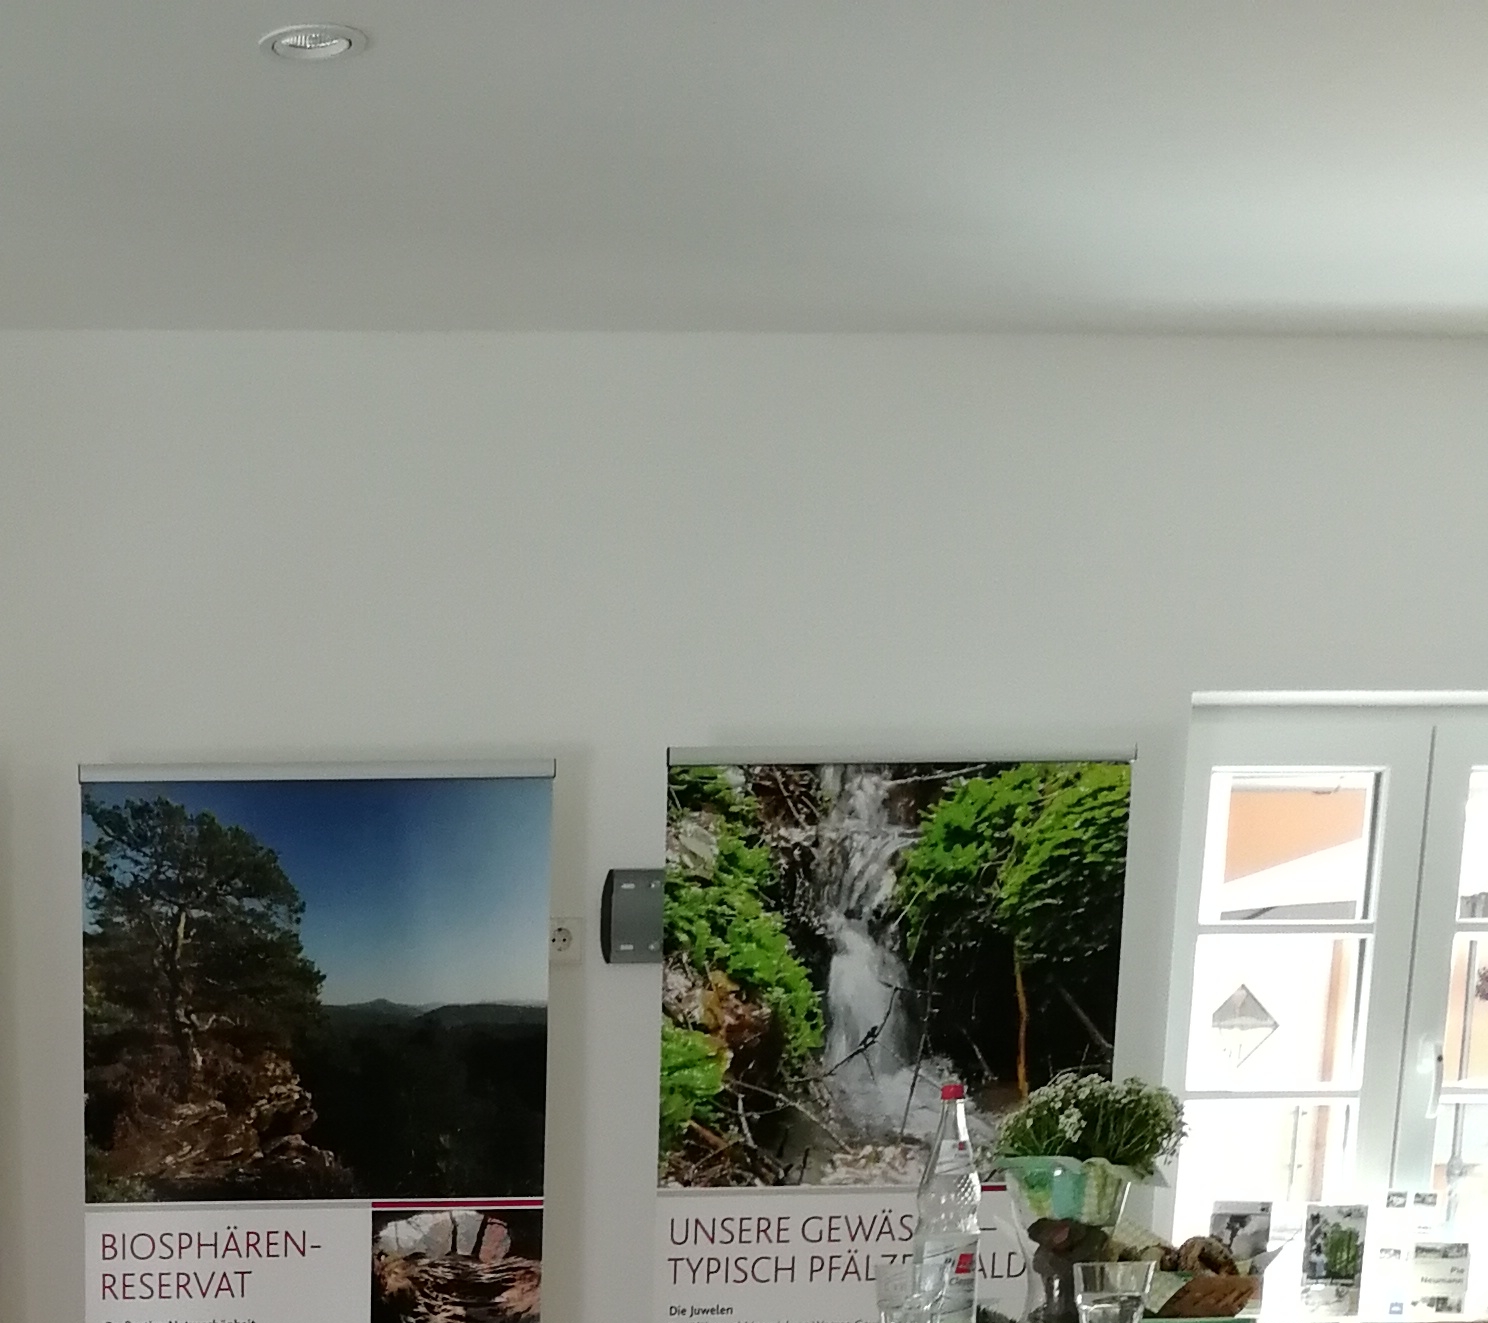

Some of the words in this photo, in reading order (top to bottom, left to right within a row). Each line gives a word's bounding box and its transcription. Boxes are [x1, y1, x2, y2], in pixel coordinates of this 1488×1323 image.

[670, 1217, 790, 1245] UNSERE
[801, 1210, 913, 1243] GEWÄS
[101, 1225, 322, 1261] BIOSPHÄREN-
[668, 1255, 795, 1284] TYPISCH
[101, 1271, 252, 1300] RESERVAT
[669, 1305, 686, 1316] Die
[689, 1304, 733, 1315] Juwelen
